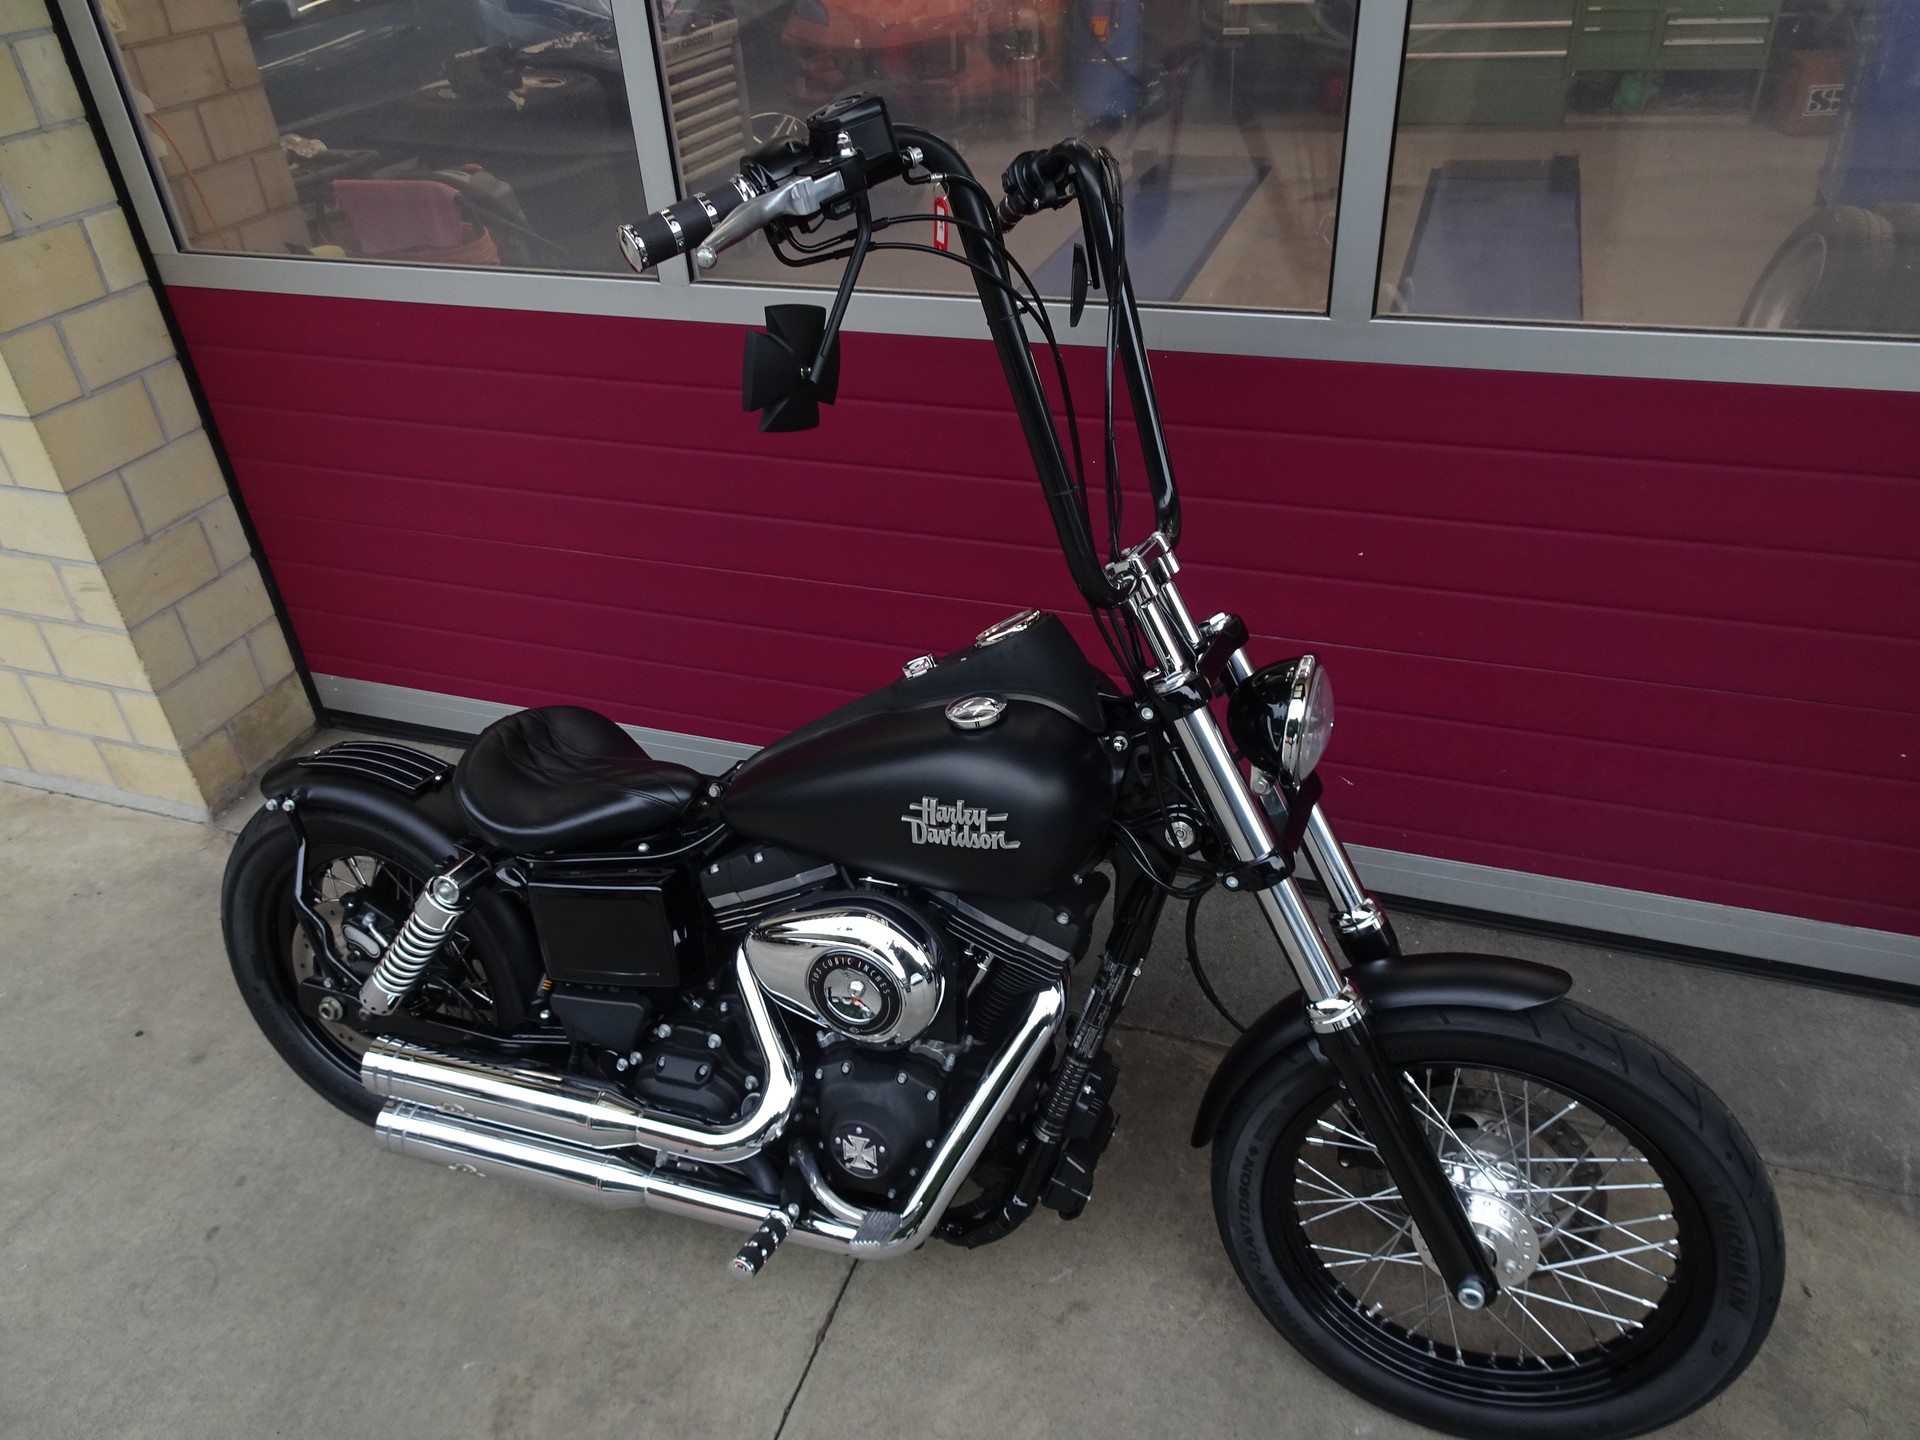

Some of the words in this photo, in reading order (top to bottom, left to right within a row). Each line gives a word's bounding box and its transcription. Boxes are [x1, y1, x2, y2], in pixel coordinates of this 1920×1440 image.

[901, 815, 1021, 850] Davidson
[909, 796, 1008, 833] Harley
[822, 956, 852, 969] CUBIC
[858, 960, 890, 994] INCHES
